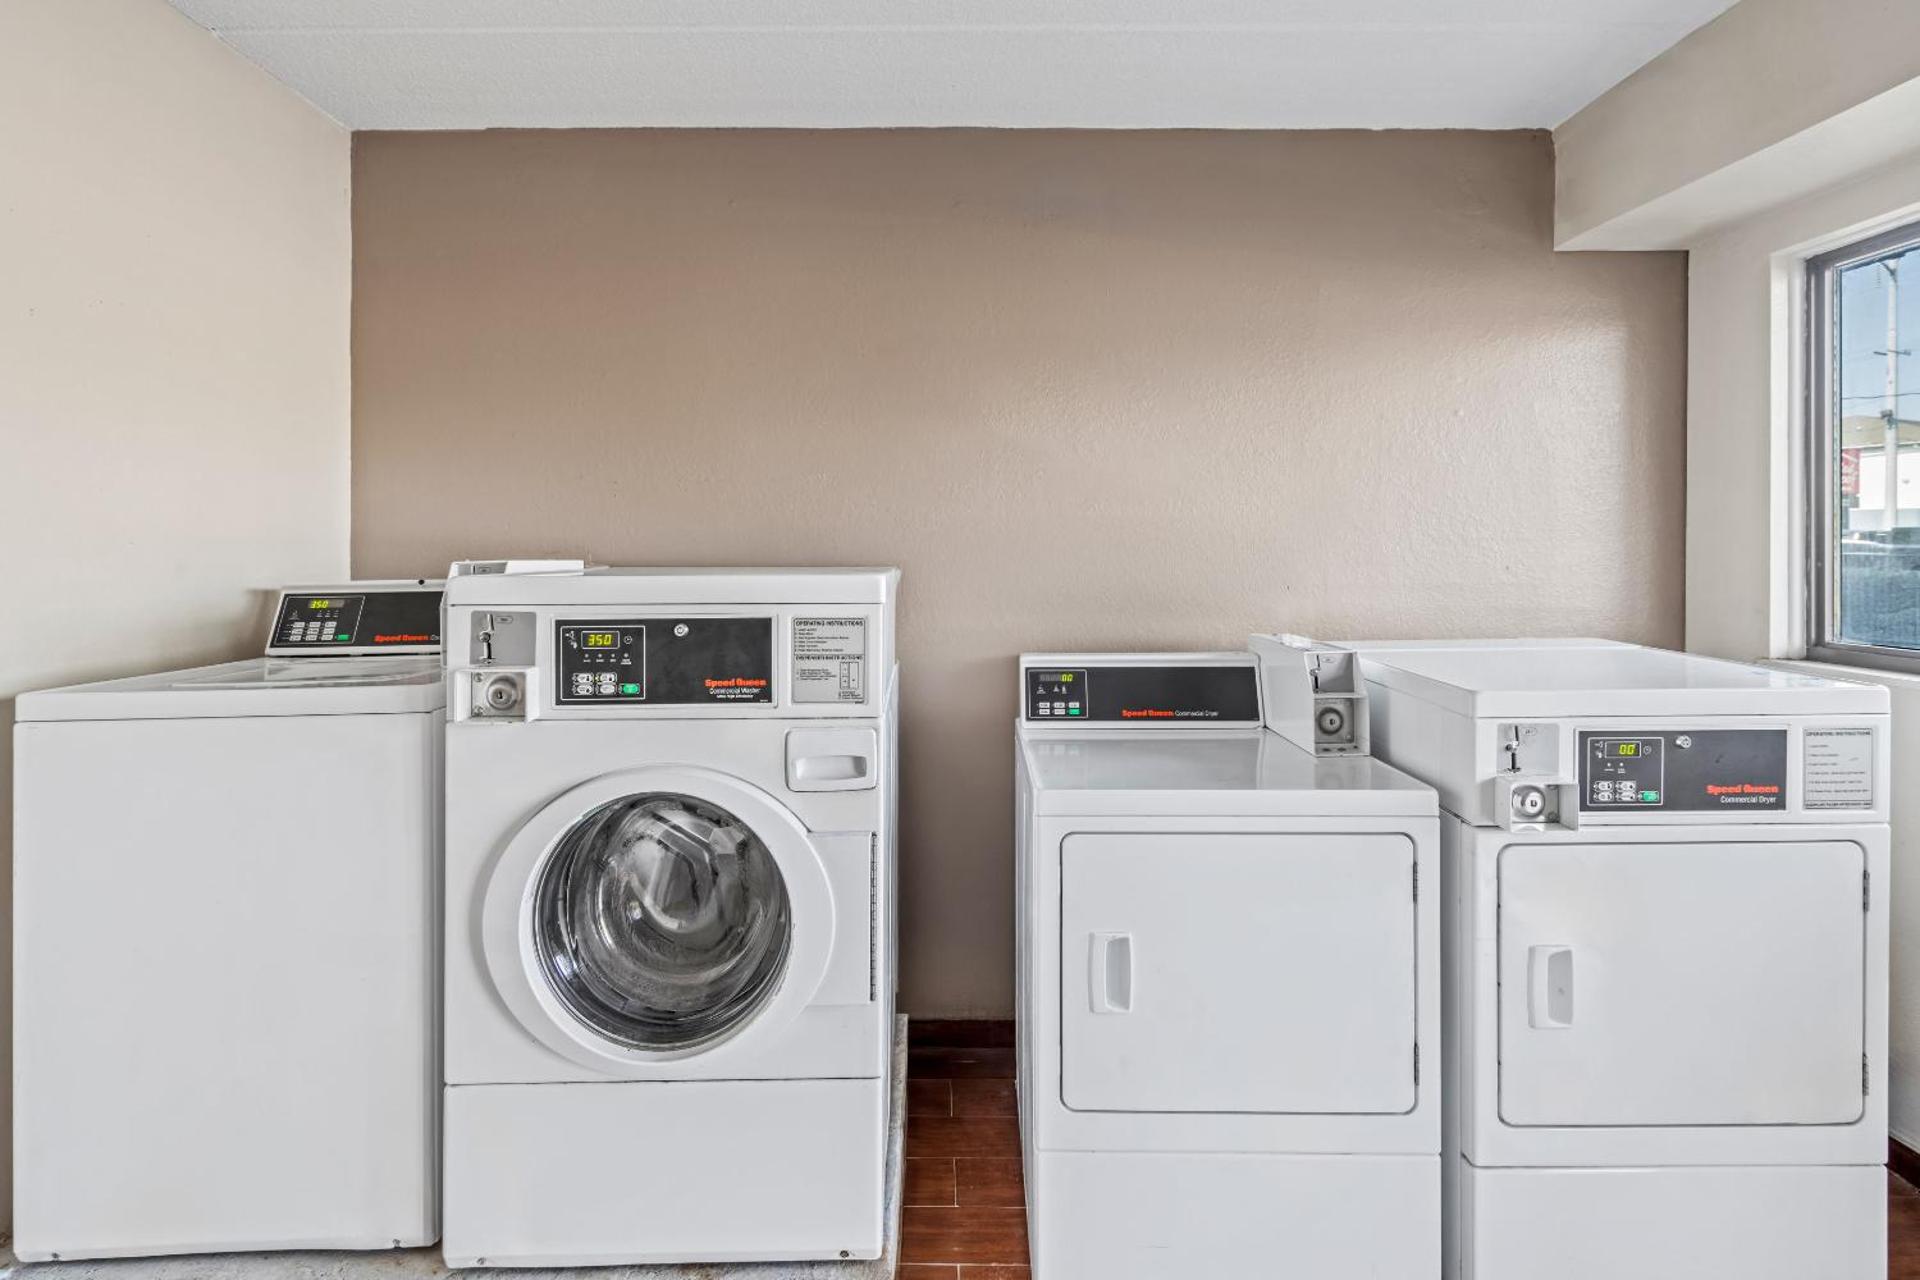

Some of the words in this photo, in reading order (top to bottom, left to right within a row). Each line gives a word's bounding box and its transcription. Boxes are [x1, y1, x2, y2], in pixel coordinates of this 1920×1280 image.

[588, 634, 612, 646] 350
[704, 678, 736, 688] Speed
[736, 678, 767, 686] Queen
[1121, 709, 1147, 717] Speed
[1619, 744, 1636, 755] 00
[1706, 785, 1742, 795] Speed
[1743, 784, 1779, 793] Queen
[1720, 795, 1757, 803] Commercial
[1758, 795, 1776, 804] Dryer
